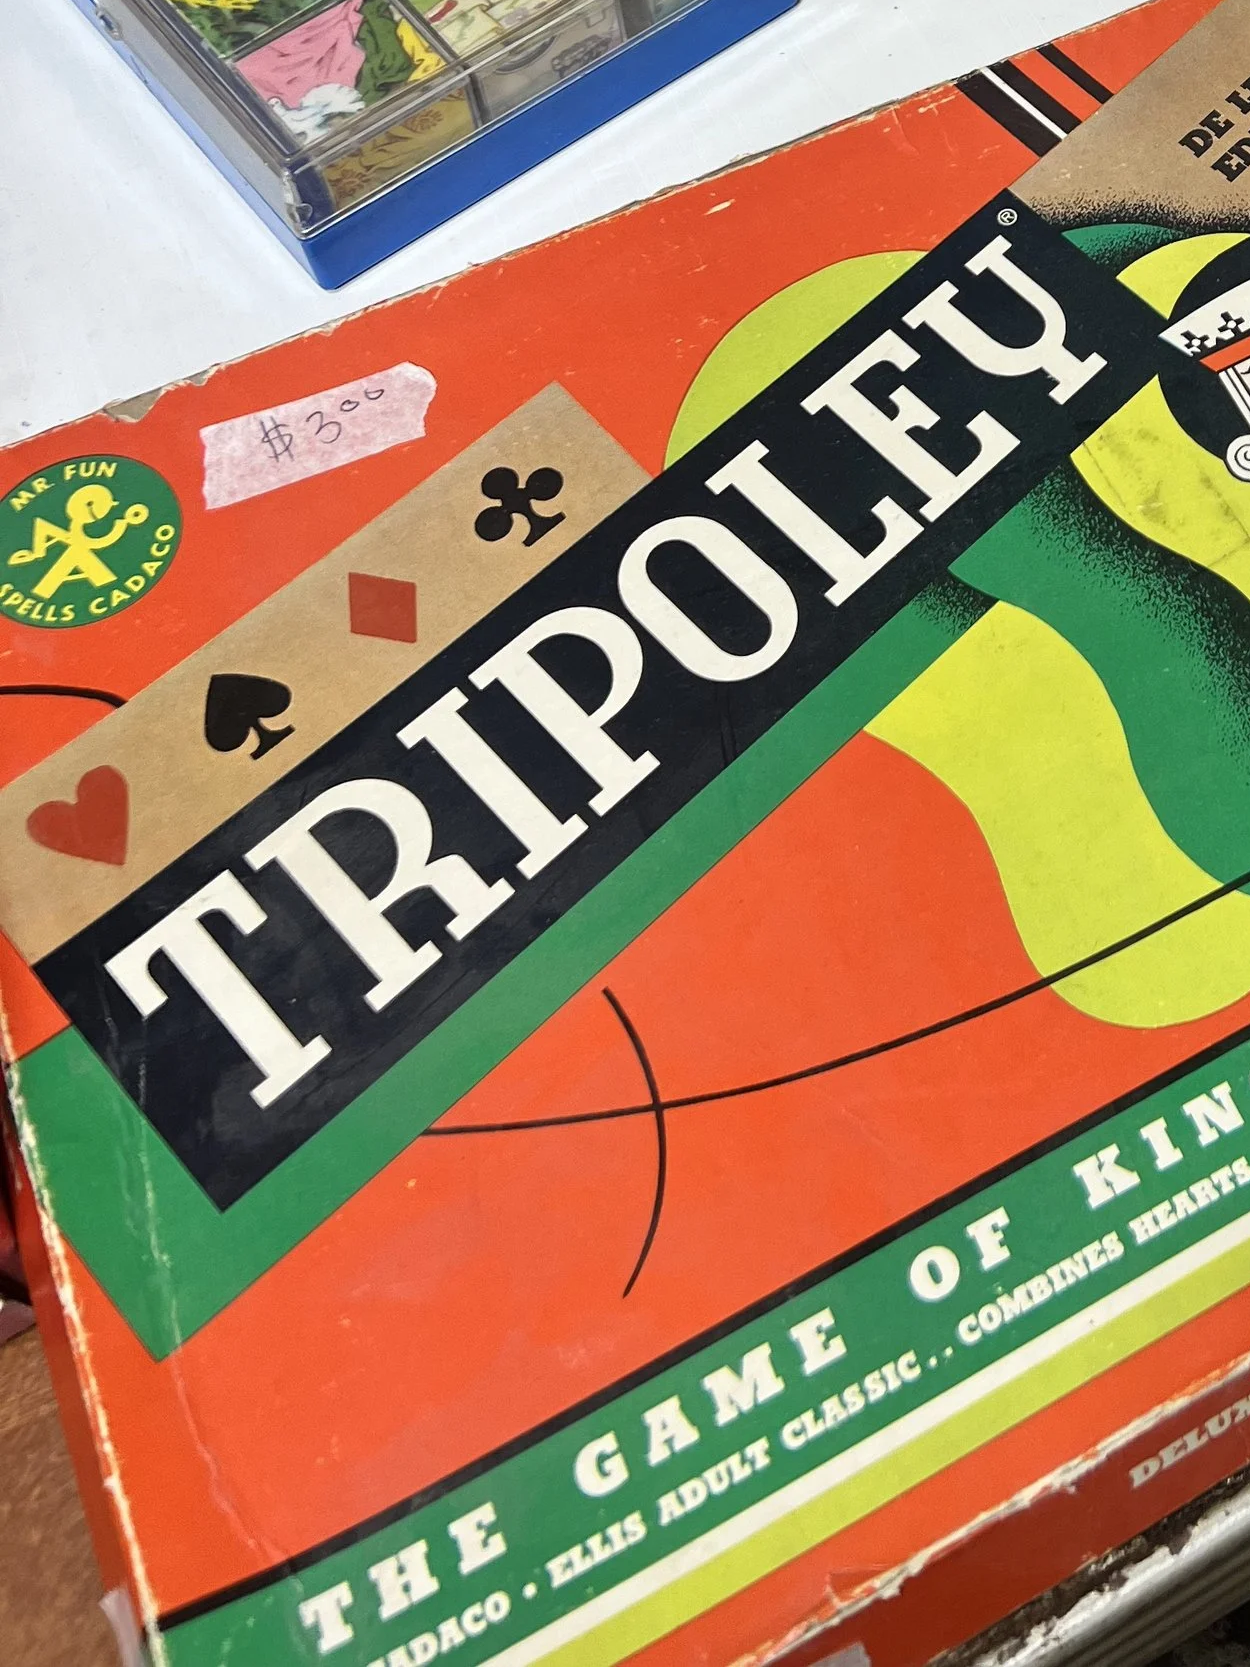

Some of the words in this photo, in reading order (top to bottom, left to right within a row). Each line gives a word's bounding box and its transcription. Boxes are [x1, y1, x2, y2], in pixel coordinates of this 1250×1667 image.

[1178, 109, 1234, 158] DE
[10, 477, 52, 511] MR
[63, 460, 119, 480] FUN
[88, 524, 176, 615] CADACO
[105, 237, 1107, 1110] TRIPOLEY
[298, 1501, 507, 1654] THE
[573, 1307, 848, 1498] GAME
[909, 1207, 1011, 1303] OF
[367, 1591, 512, 1667] ADACO
[545, 1510, 648, 1589] ELLIS
[656, 1437, 773, 1526] ADULT
[956, 1230, 1126, 1347] COMBINES
